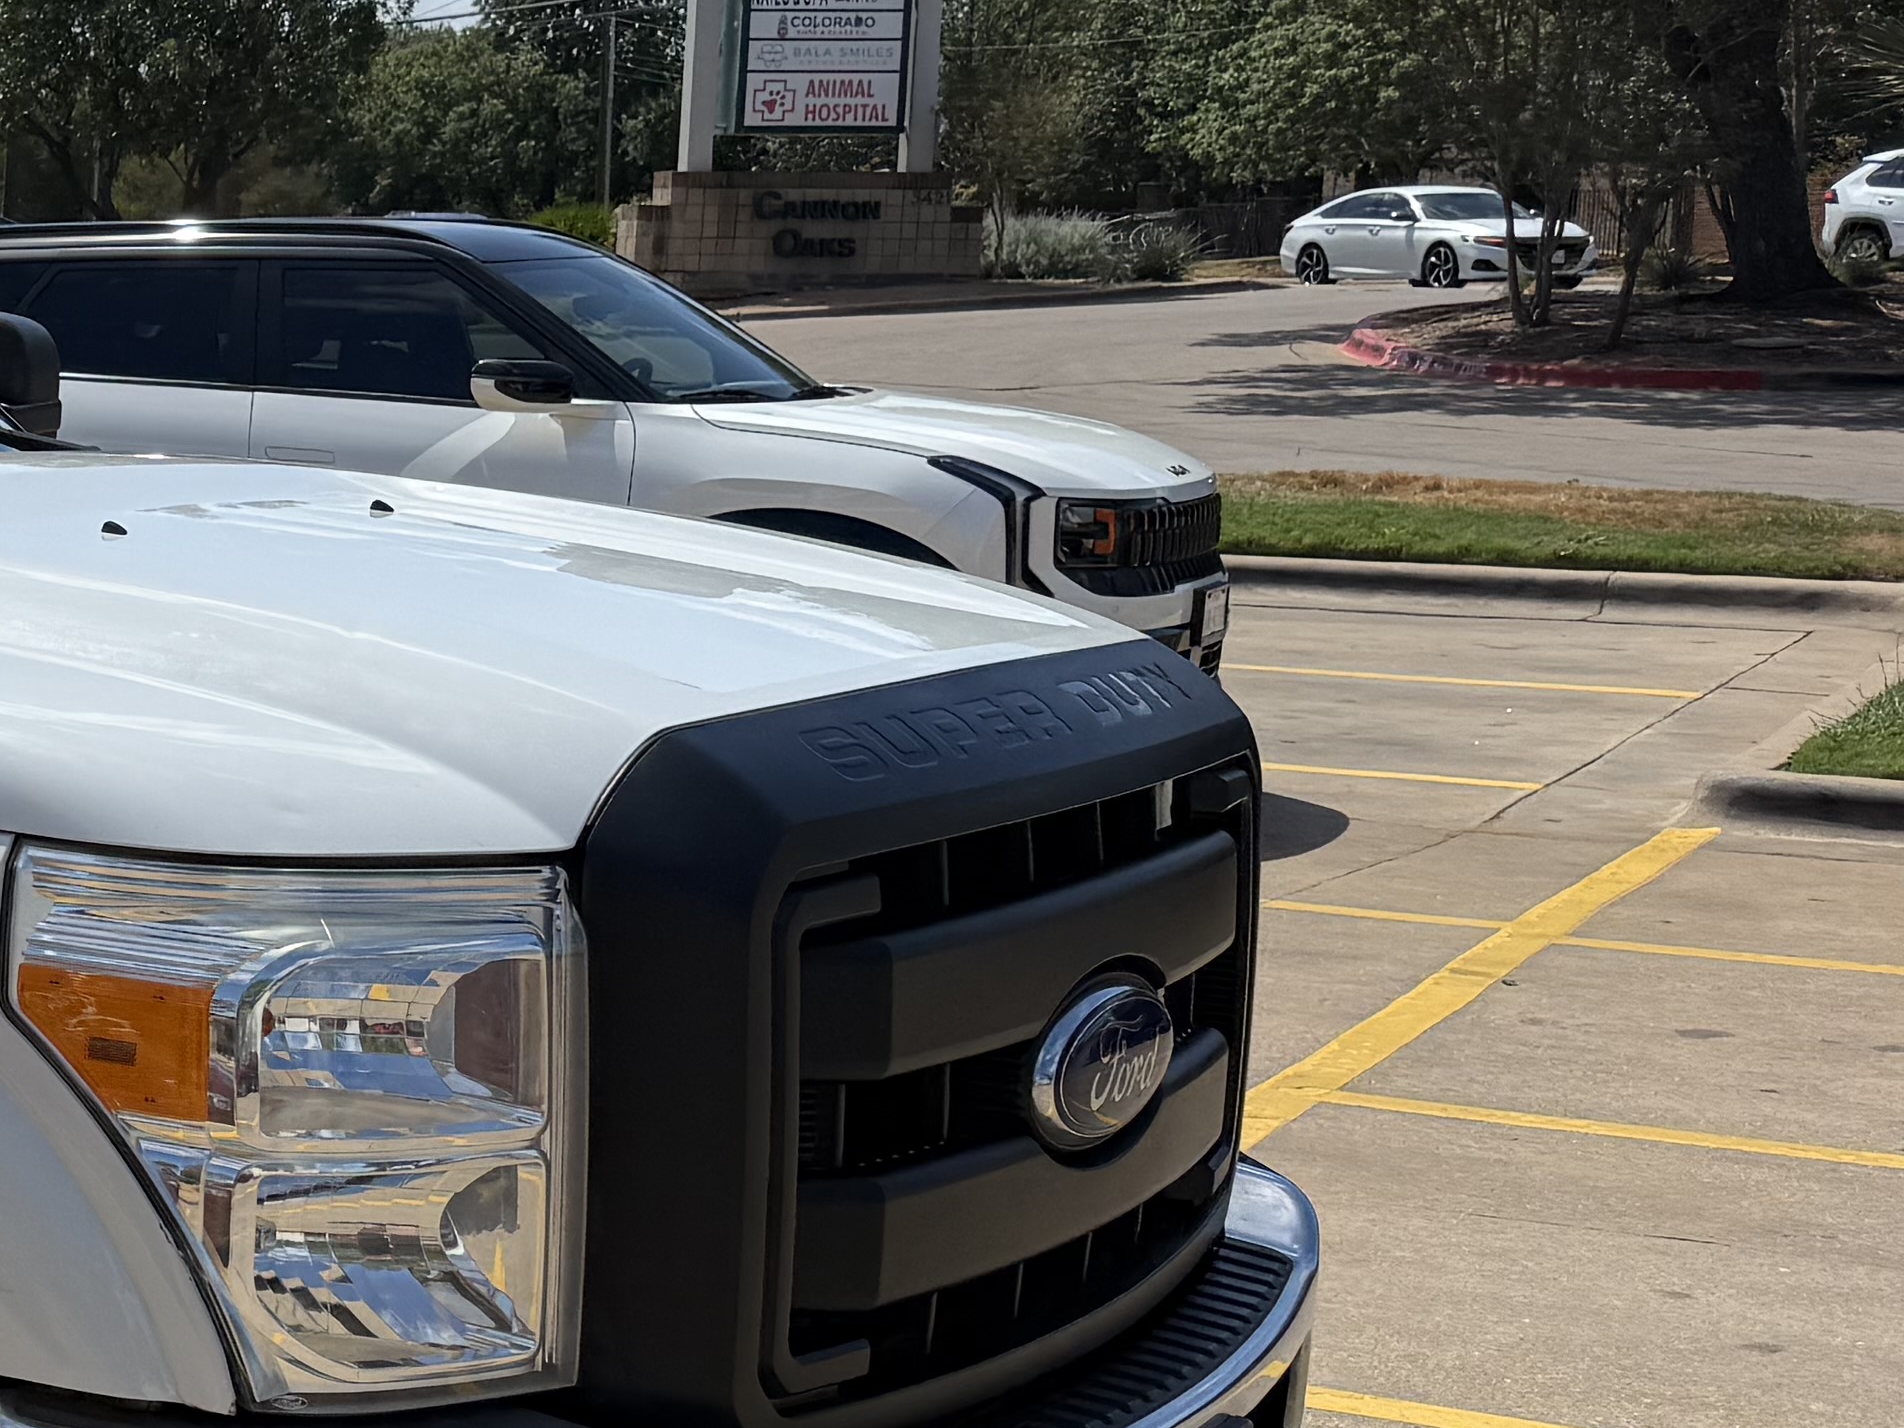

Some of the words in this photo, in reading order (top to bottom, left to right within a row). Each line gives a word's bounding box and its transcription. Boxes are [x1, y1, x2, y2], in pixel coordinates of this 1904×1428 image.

[790, 15, 876, 28] COLORADO
[841, 47, 894, 58] SMILES
[804, 79, 875, 98] ANIMAL
[804, 103, 889, 122] HOSPITAL
[797, 688, 1074, 782] SUPER
[1057, 661, 1192, 727] DUTY
[1090, 1013, 1162, 1112] Ford
